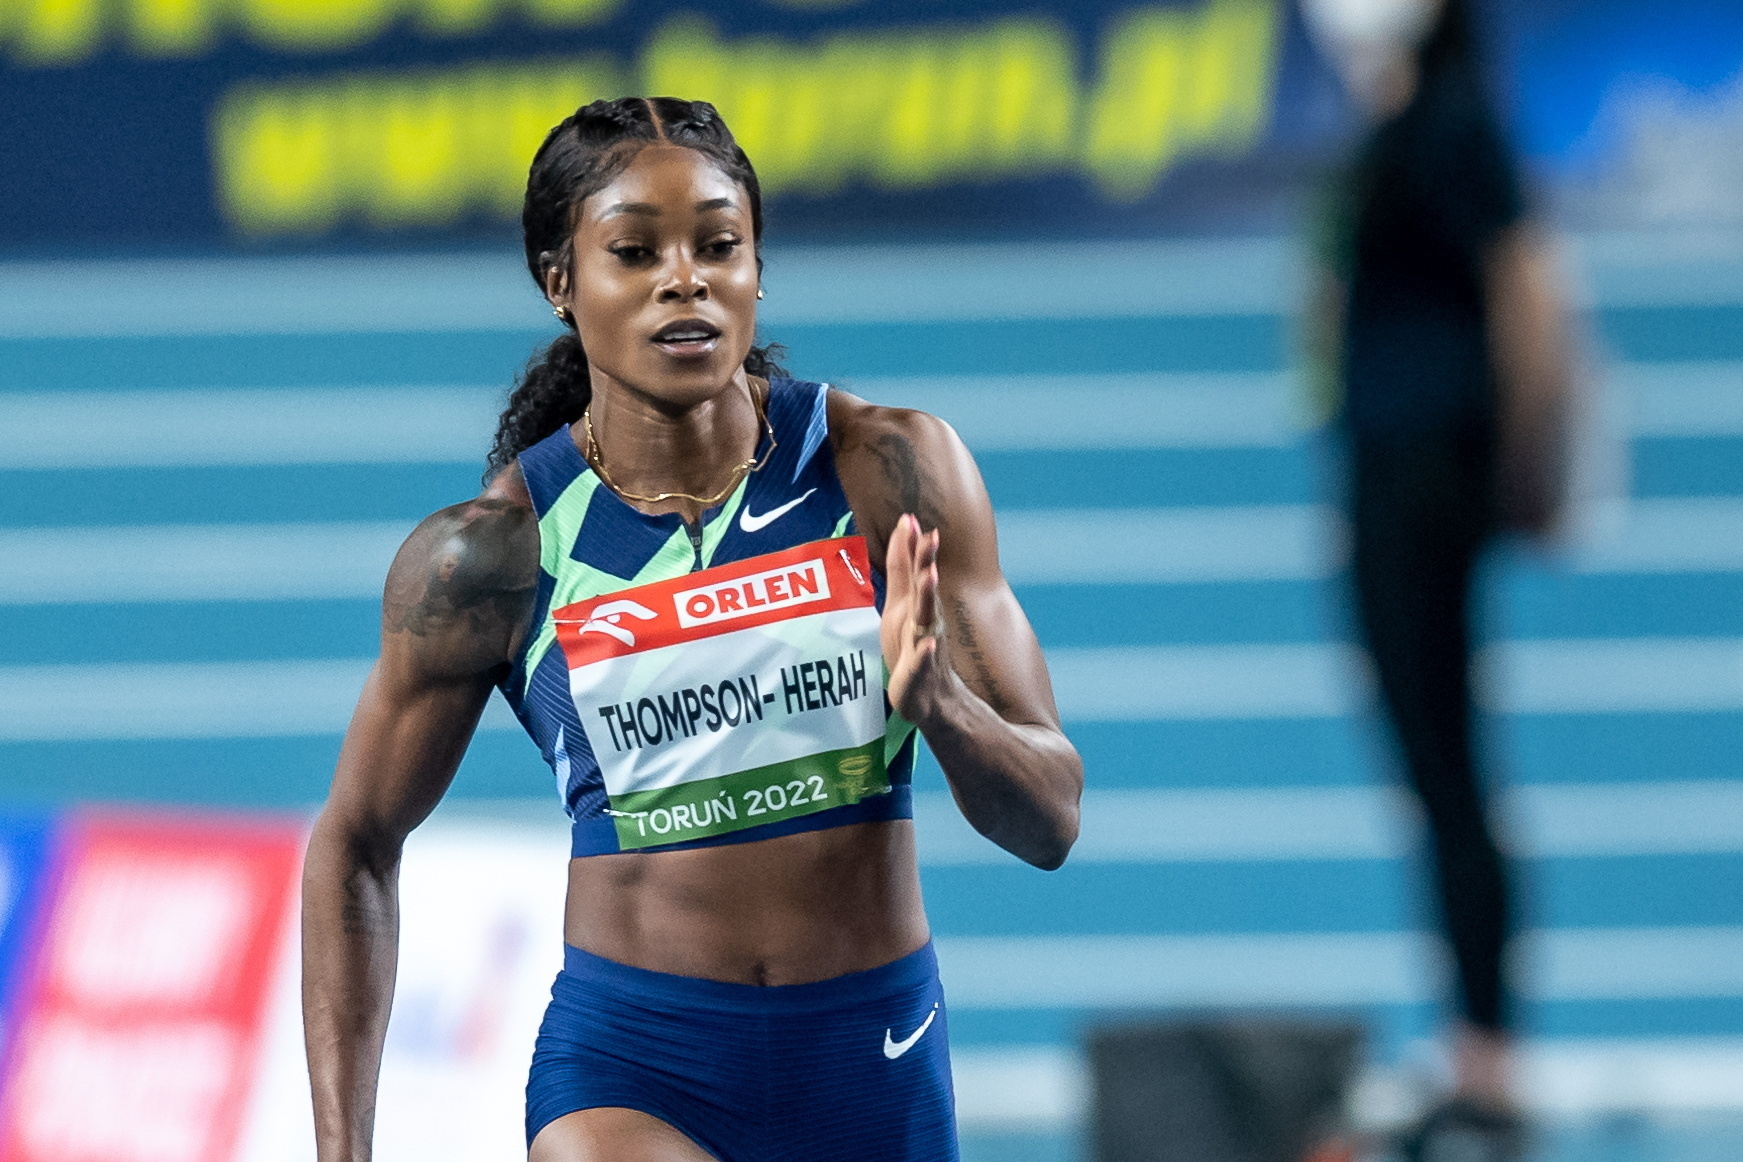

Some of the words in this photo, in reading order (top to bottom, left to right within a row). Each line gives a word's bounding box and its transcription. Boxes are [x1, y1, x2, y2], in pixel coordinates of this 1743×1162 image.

[209, 2, 1276, 246] wwwtorun.pl
[685, 566, 820, 619] ORLEN
[780, 650, 867, 714] HERAH
[633, 790, 737, 837] TORUŃ
[743, 775, 828, 817] 2022
